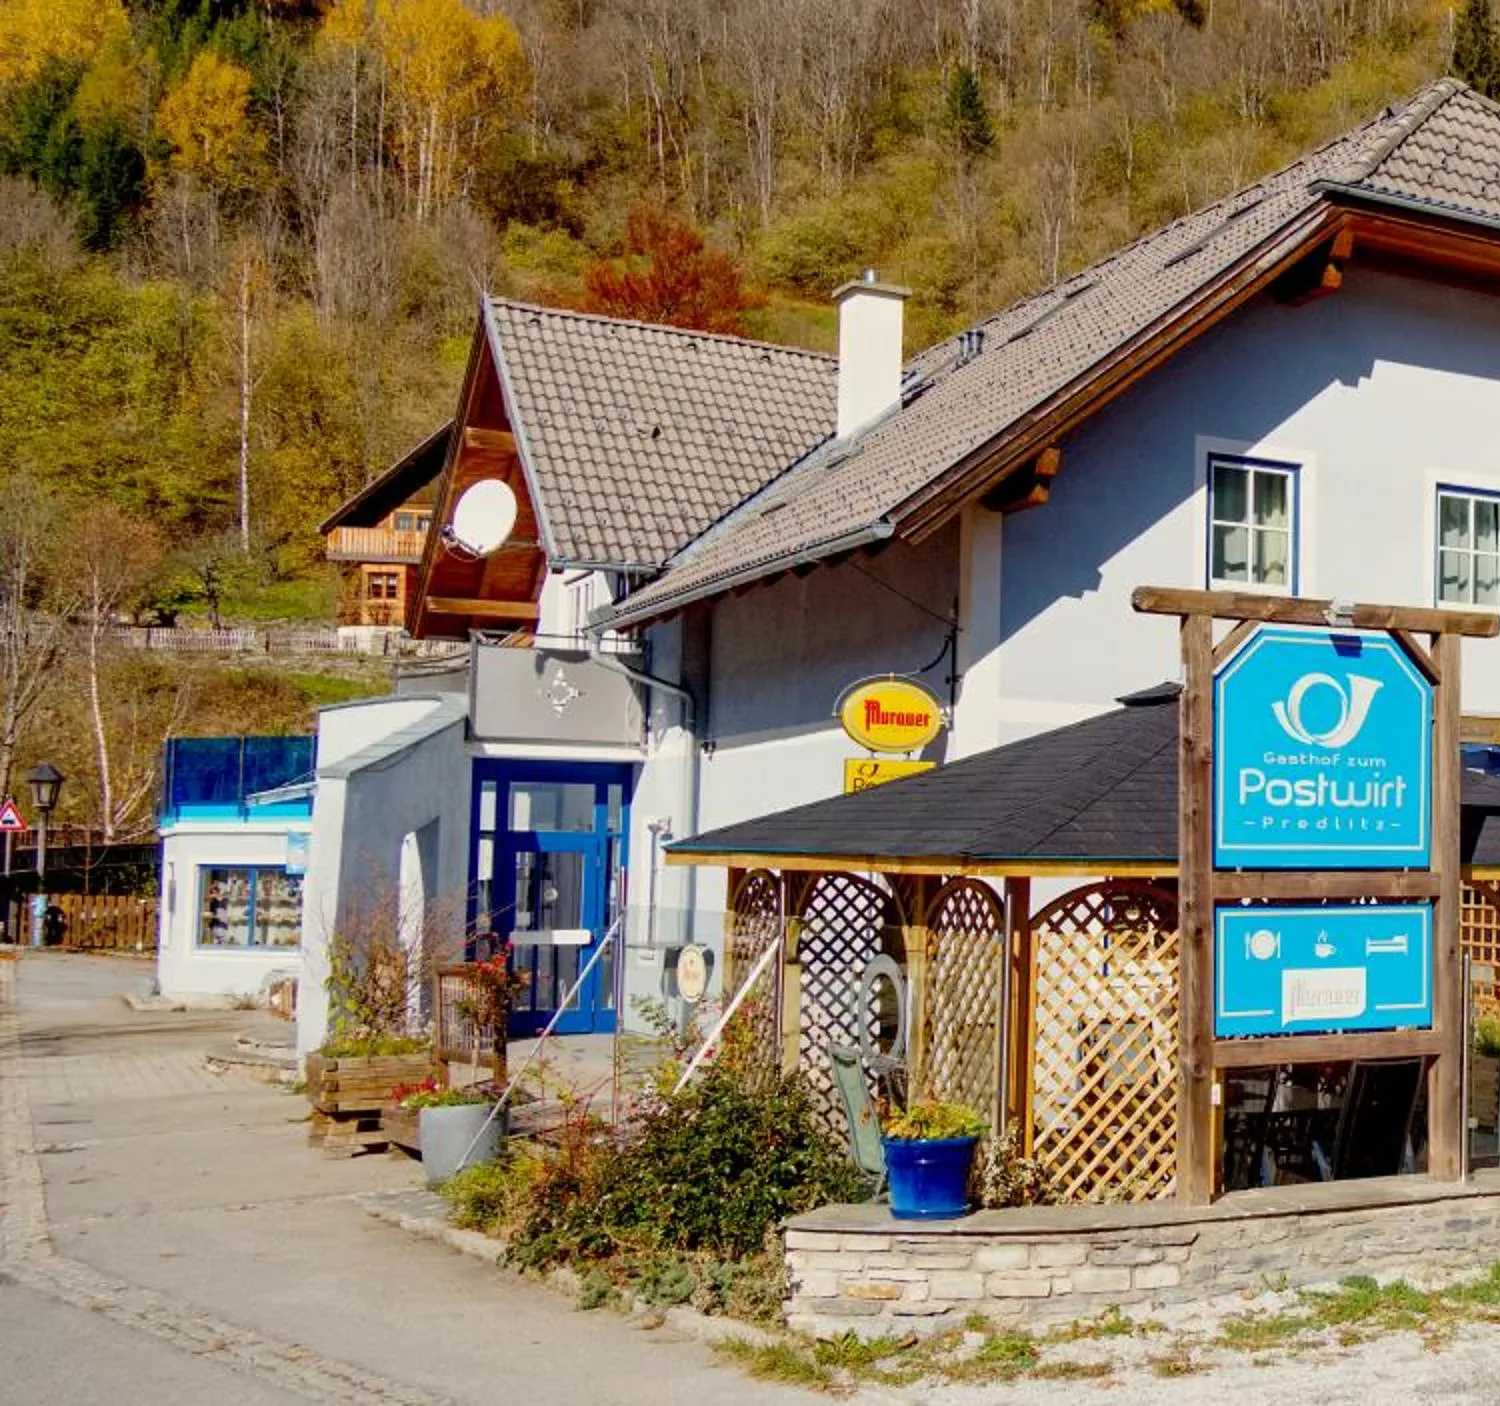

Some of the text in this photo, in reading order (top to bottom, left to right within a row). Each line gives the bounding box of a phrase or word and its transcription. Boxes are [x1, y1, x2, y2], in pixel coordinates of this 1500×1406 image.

[864, 699, 932, 732] Murauer
[1263, 751, 1386, 768] Gasthof zum
[1238, 767, 1407, 808] Postwirt
